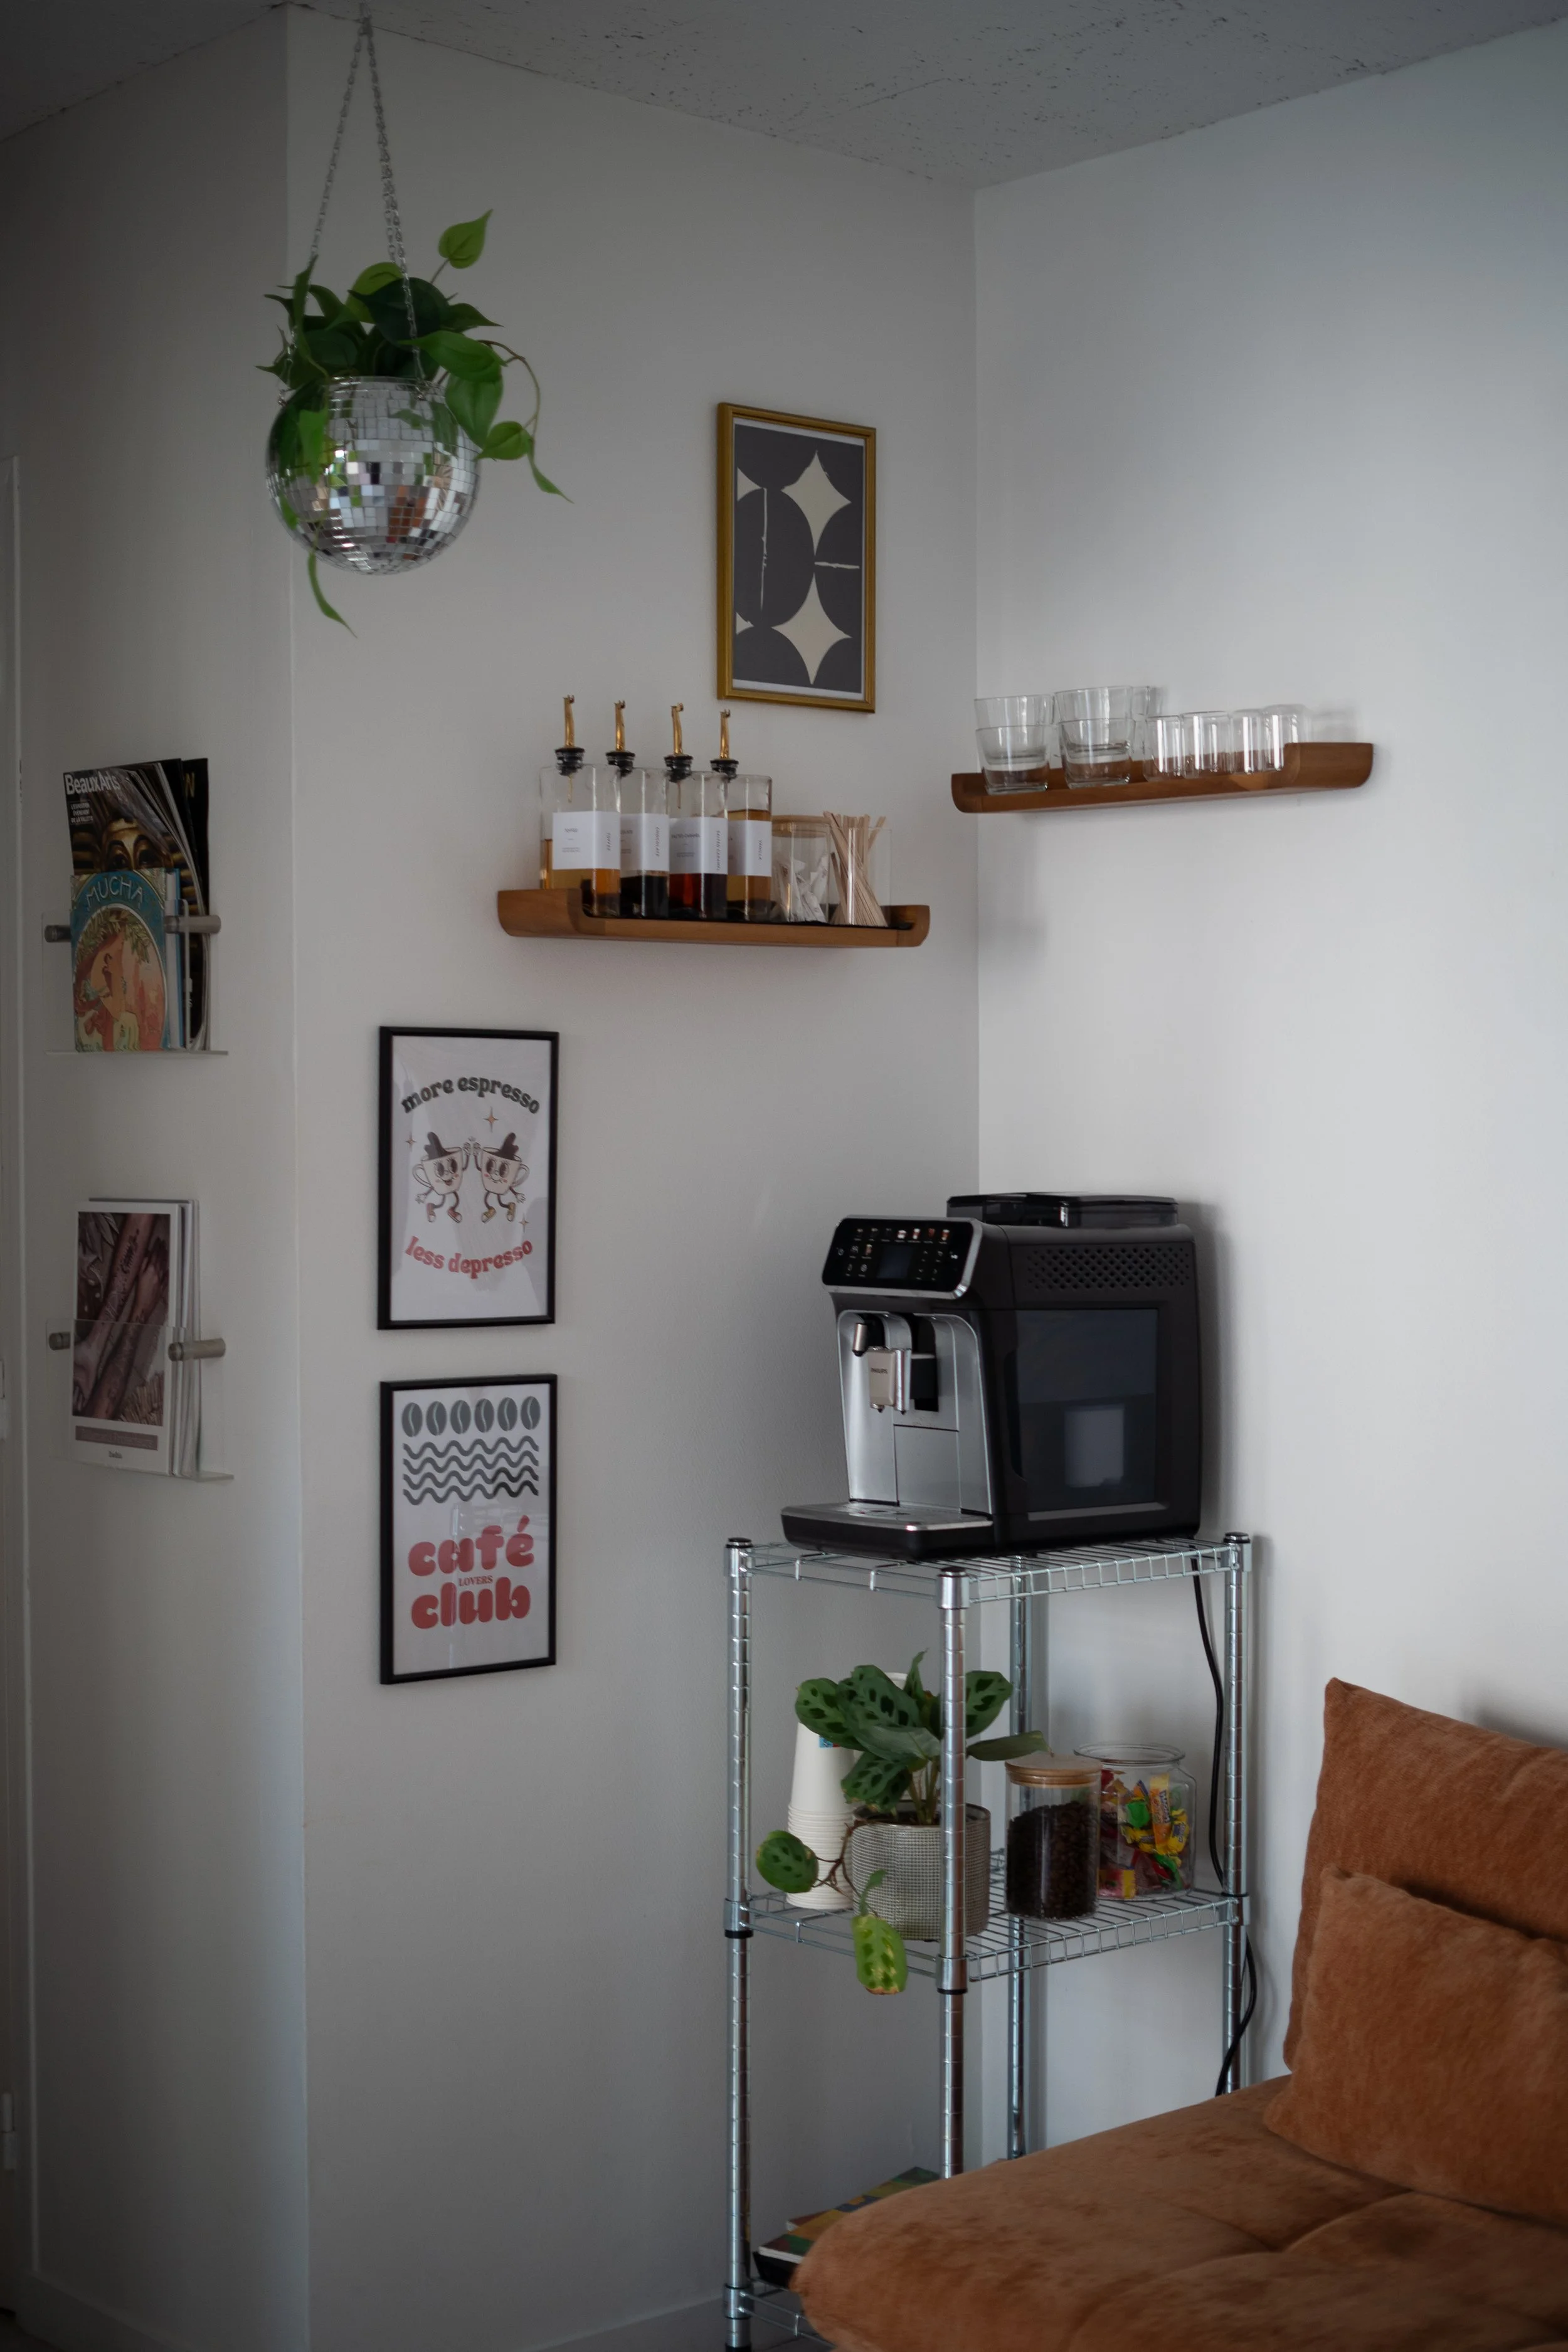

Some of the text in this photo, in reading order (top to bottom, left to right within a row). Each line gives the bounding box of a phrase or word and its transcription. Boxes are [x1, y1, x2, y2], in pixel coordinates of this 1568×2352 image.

[86, 876, 142, 908] MUCHA
[401, 1076, 540, 1115] more espresso
[405, 1235, 534, 1279] less depresso
[408, 1515, 534, 1577] café
[458, 1575, 493, 1587] LOVERS
[411, 1576, 531, 1629] club
